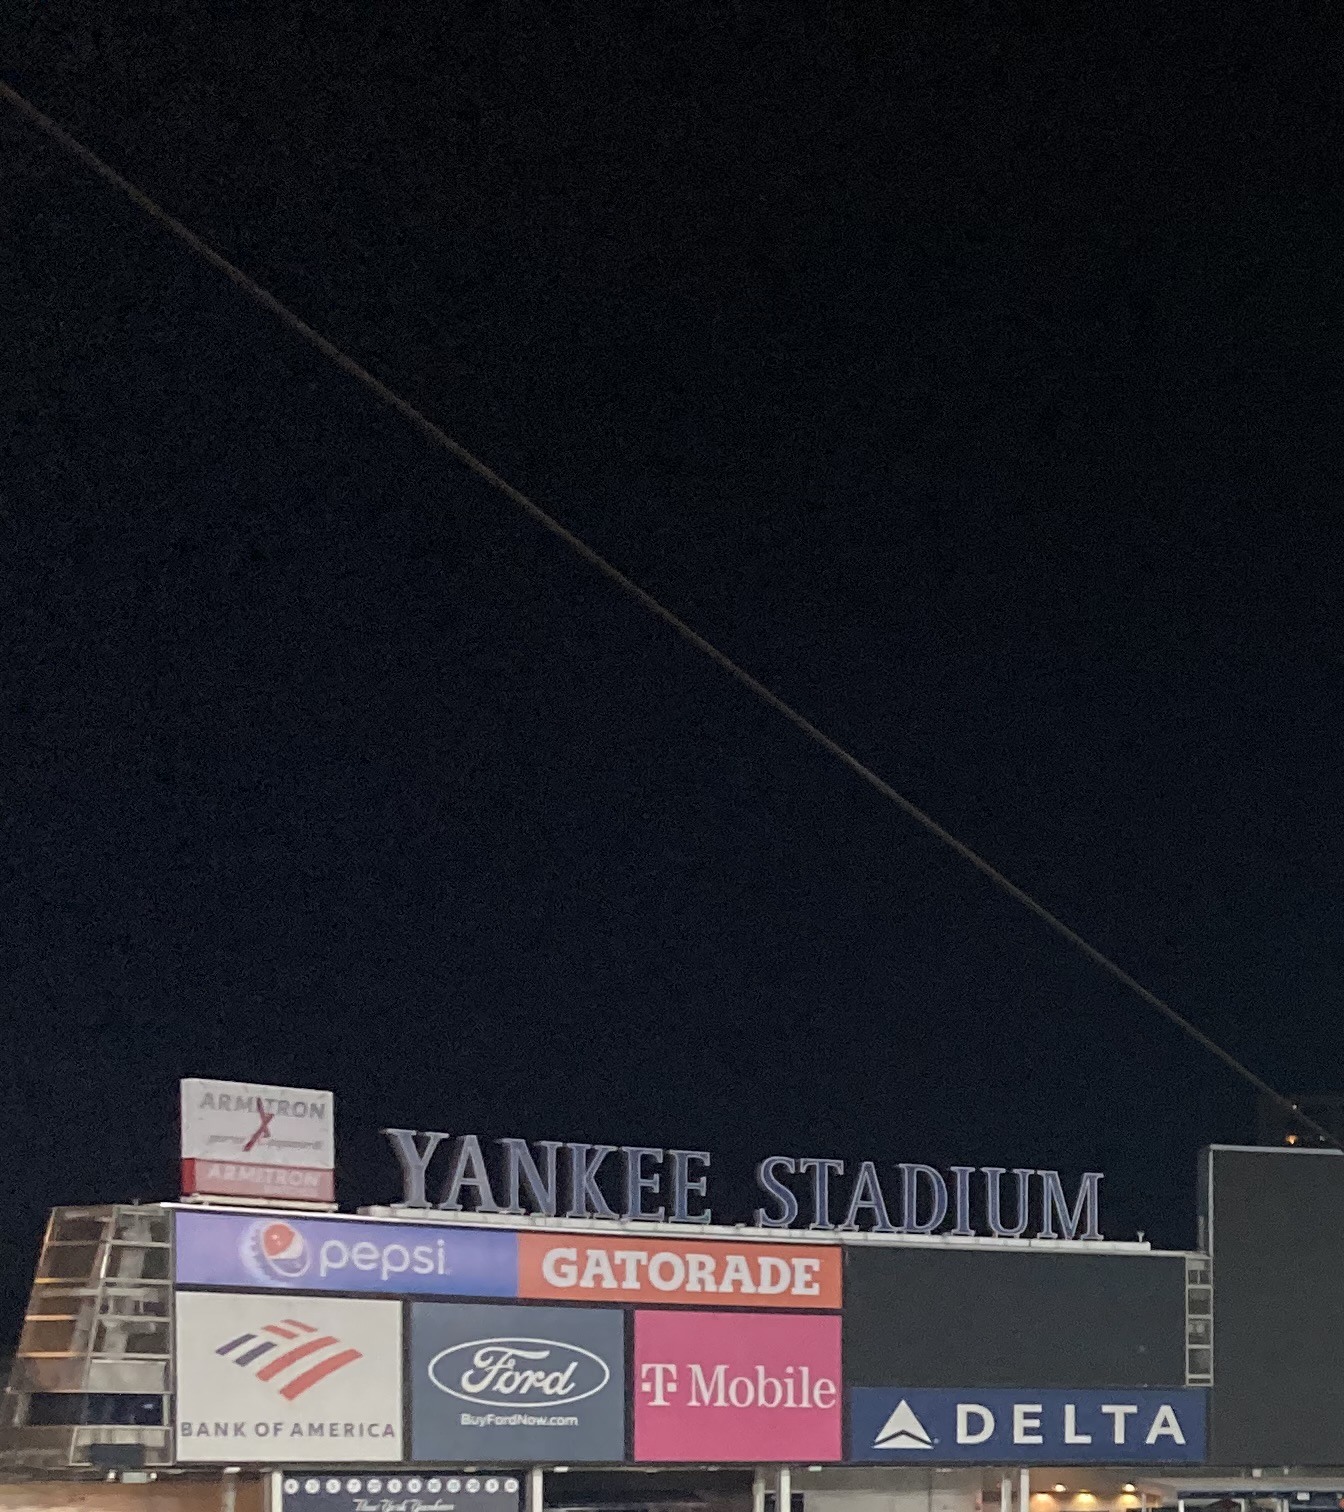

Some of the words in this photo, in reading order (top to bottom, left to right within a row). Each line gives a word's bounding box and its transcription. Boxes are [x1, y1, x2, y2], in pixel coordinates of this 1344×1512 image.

[200, 1092, 326, 1120] ARMITRON
[380, 1128, 712, 1225] YANKEE
[755, 1156, 1104, 1241] STADIUM
[320, 1239, 447, 1281] pepsi
[542, 1247, 820, 1295] GATORADE
[460, 1347, 578, 1395] Ford
[687, 1364, 837, 1410] Mobile
[181, 1421, 250, 1438] BANK
[255, 1422, 283, 1438] OF
[291, 1422, 395, 1438] AMERICA
[460, 1413, 578, 1428] BuyFordNow.com
[956, 1404, 1187, 1445] DELTA
